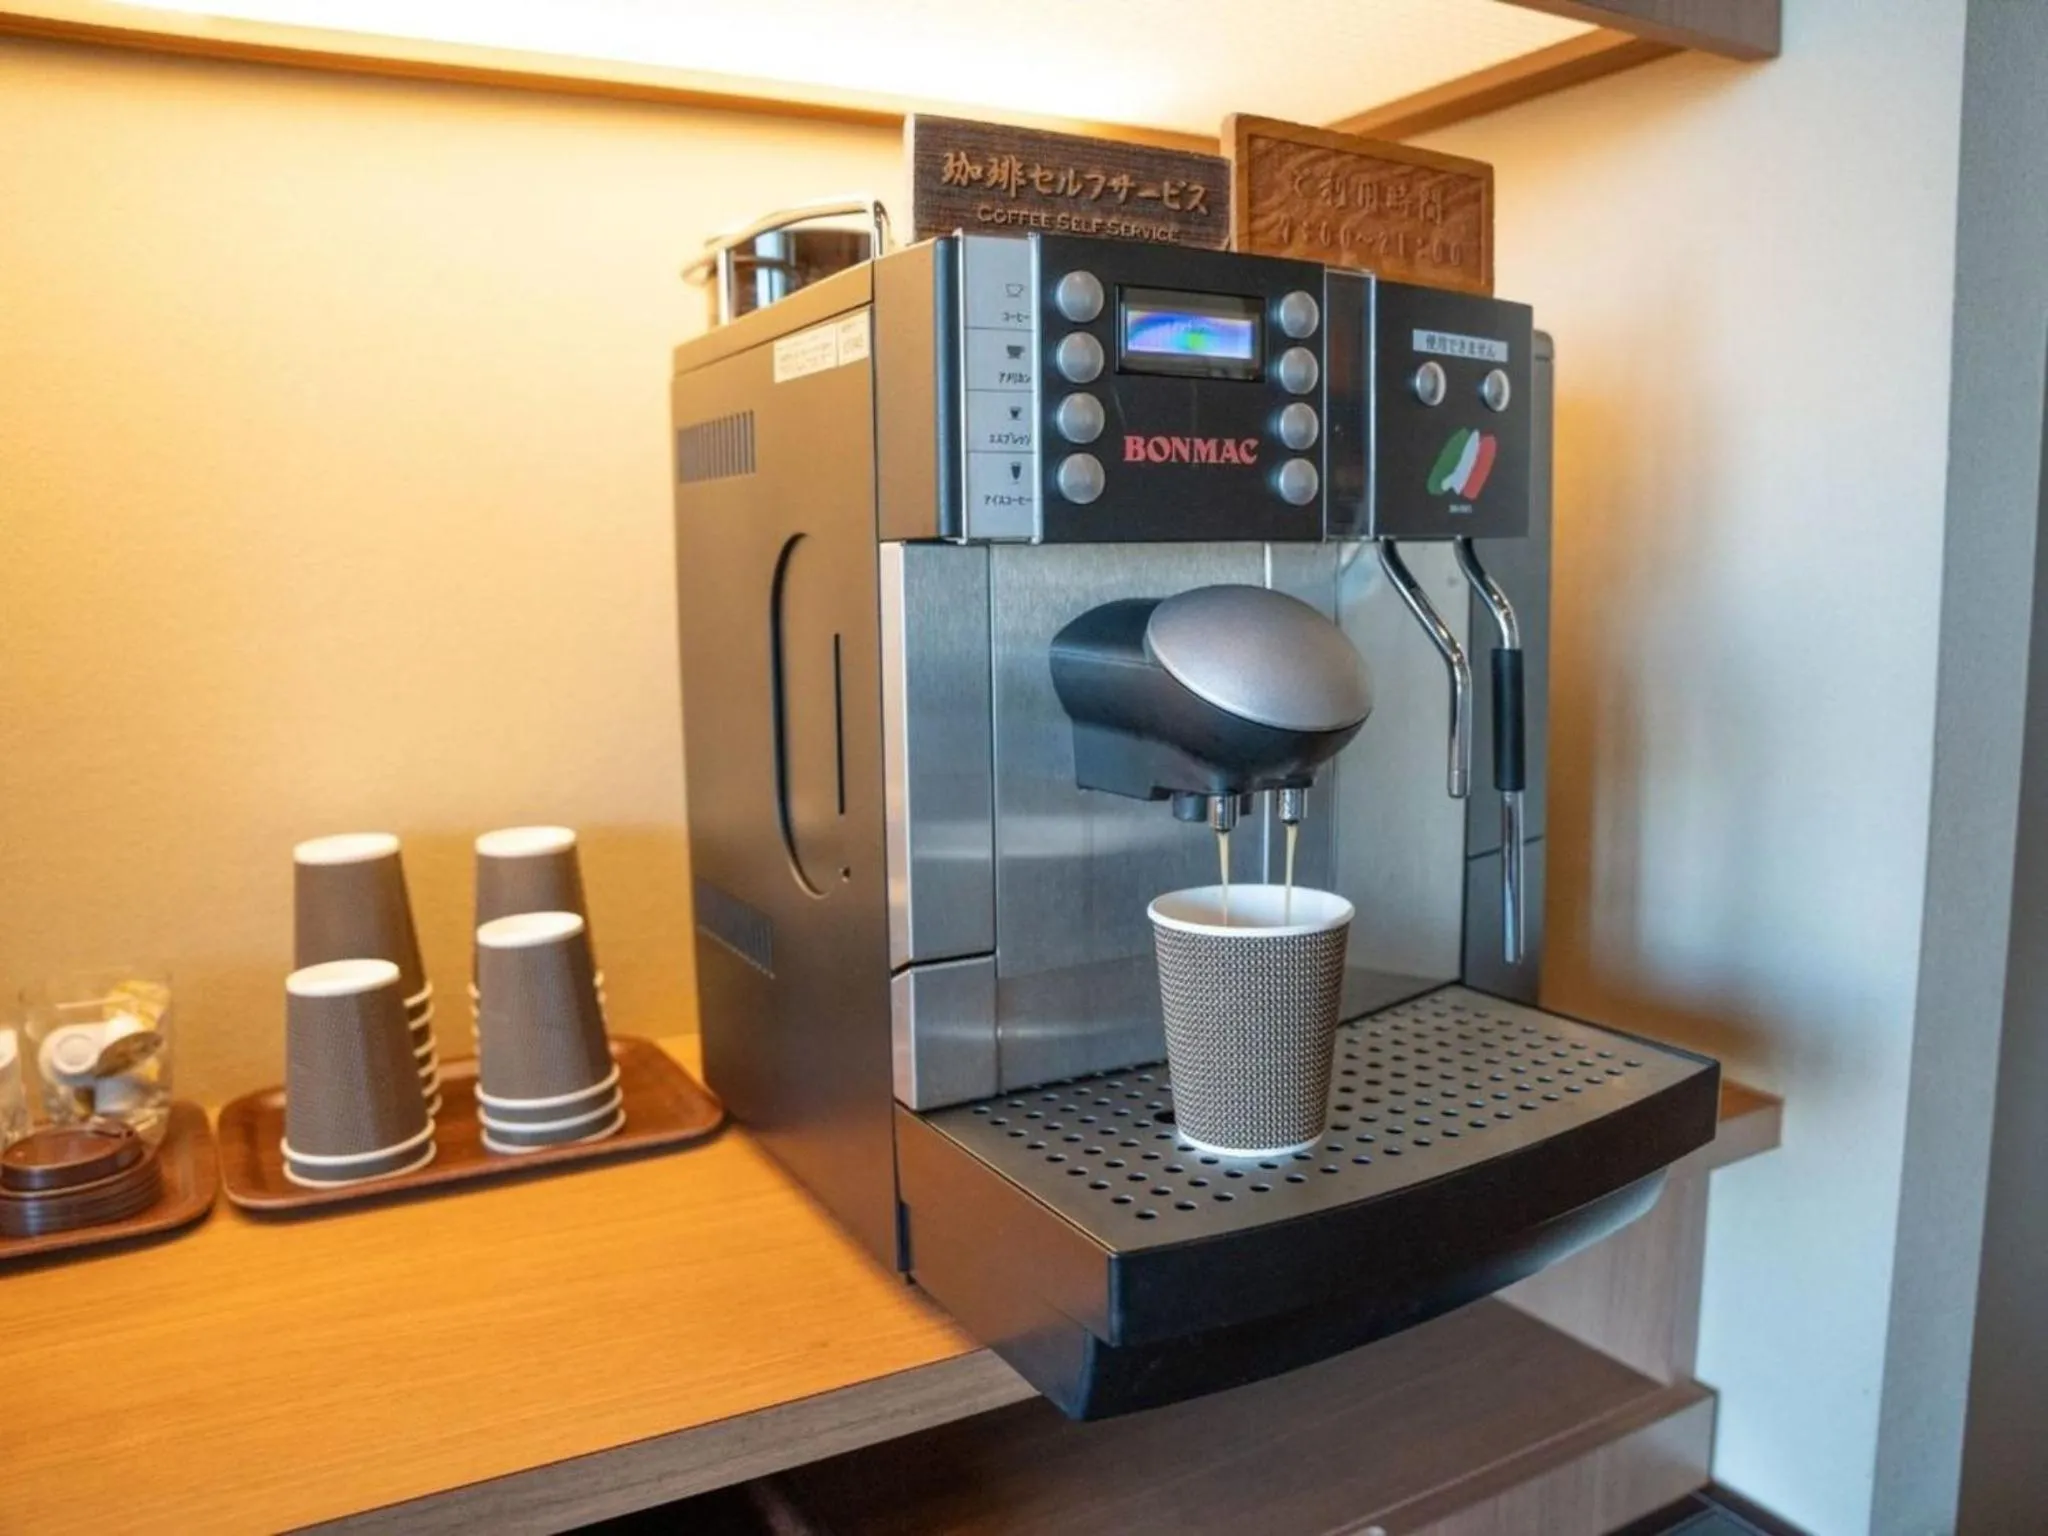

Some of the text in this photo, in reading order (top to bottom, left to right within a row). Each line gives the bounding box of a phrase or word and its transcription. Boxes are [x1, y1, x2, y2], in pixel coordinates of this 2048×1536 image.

[942, 151, 1209, 216] 珈琲セルフサービス
[977, 204, 1180, 243] COFFEE SELF SERVICE
[1003, 312, 1030, 323] コーヒー
[1425, 333, 1496, 358] 使用できません
[999, 372, 1031, 384] アメリカン
[1123, 435, 1259, 465] BONMAC
[984, 494, 1032, 506] アイスコーヒー
